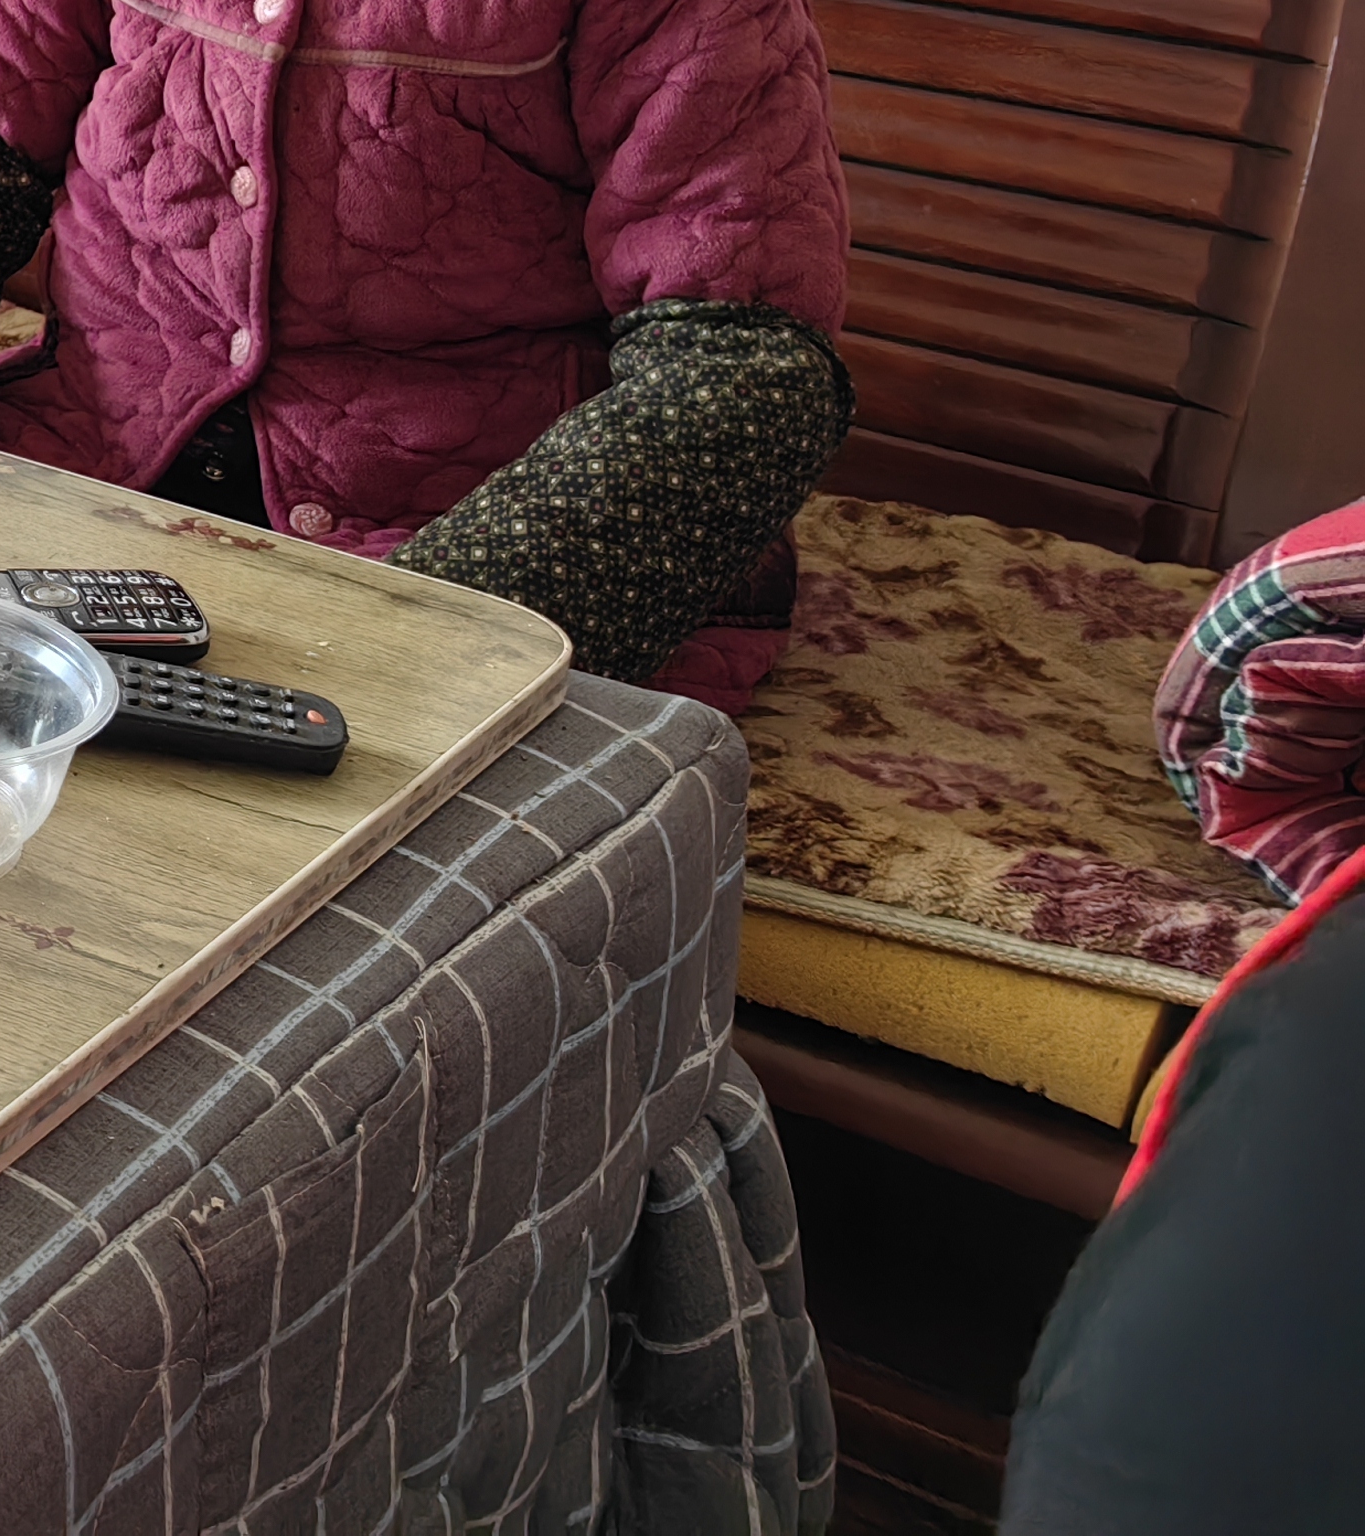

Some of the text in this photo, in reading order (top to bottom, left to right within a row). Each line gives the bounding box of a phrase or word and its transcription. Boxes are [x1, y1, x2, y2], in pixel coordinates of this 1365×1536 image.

[71, 575, 96, 584] 3
[98, 575, 124, 584] 6
[126, 575, 151, 584] 9
[86, 595, 109, 605] 2
[113, 595, 137, 605] 5
[141, 595, 165, 605] 8
[170, 597, 192, 606] 0
[125, 617, 147, 629] 4
[152, 617, 178, 629] 7
